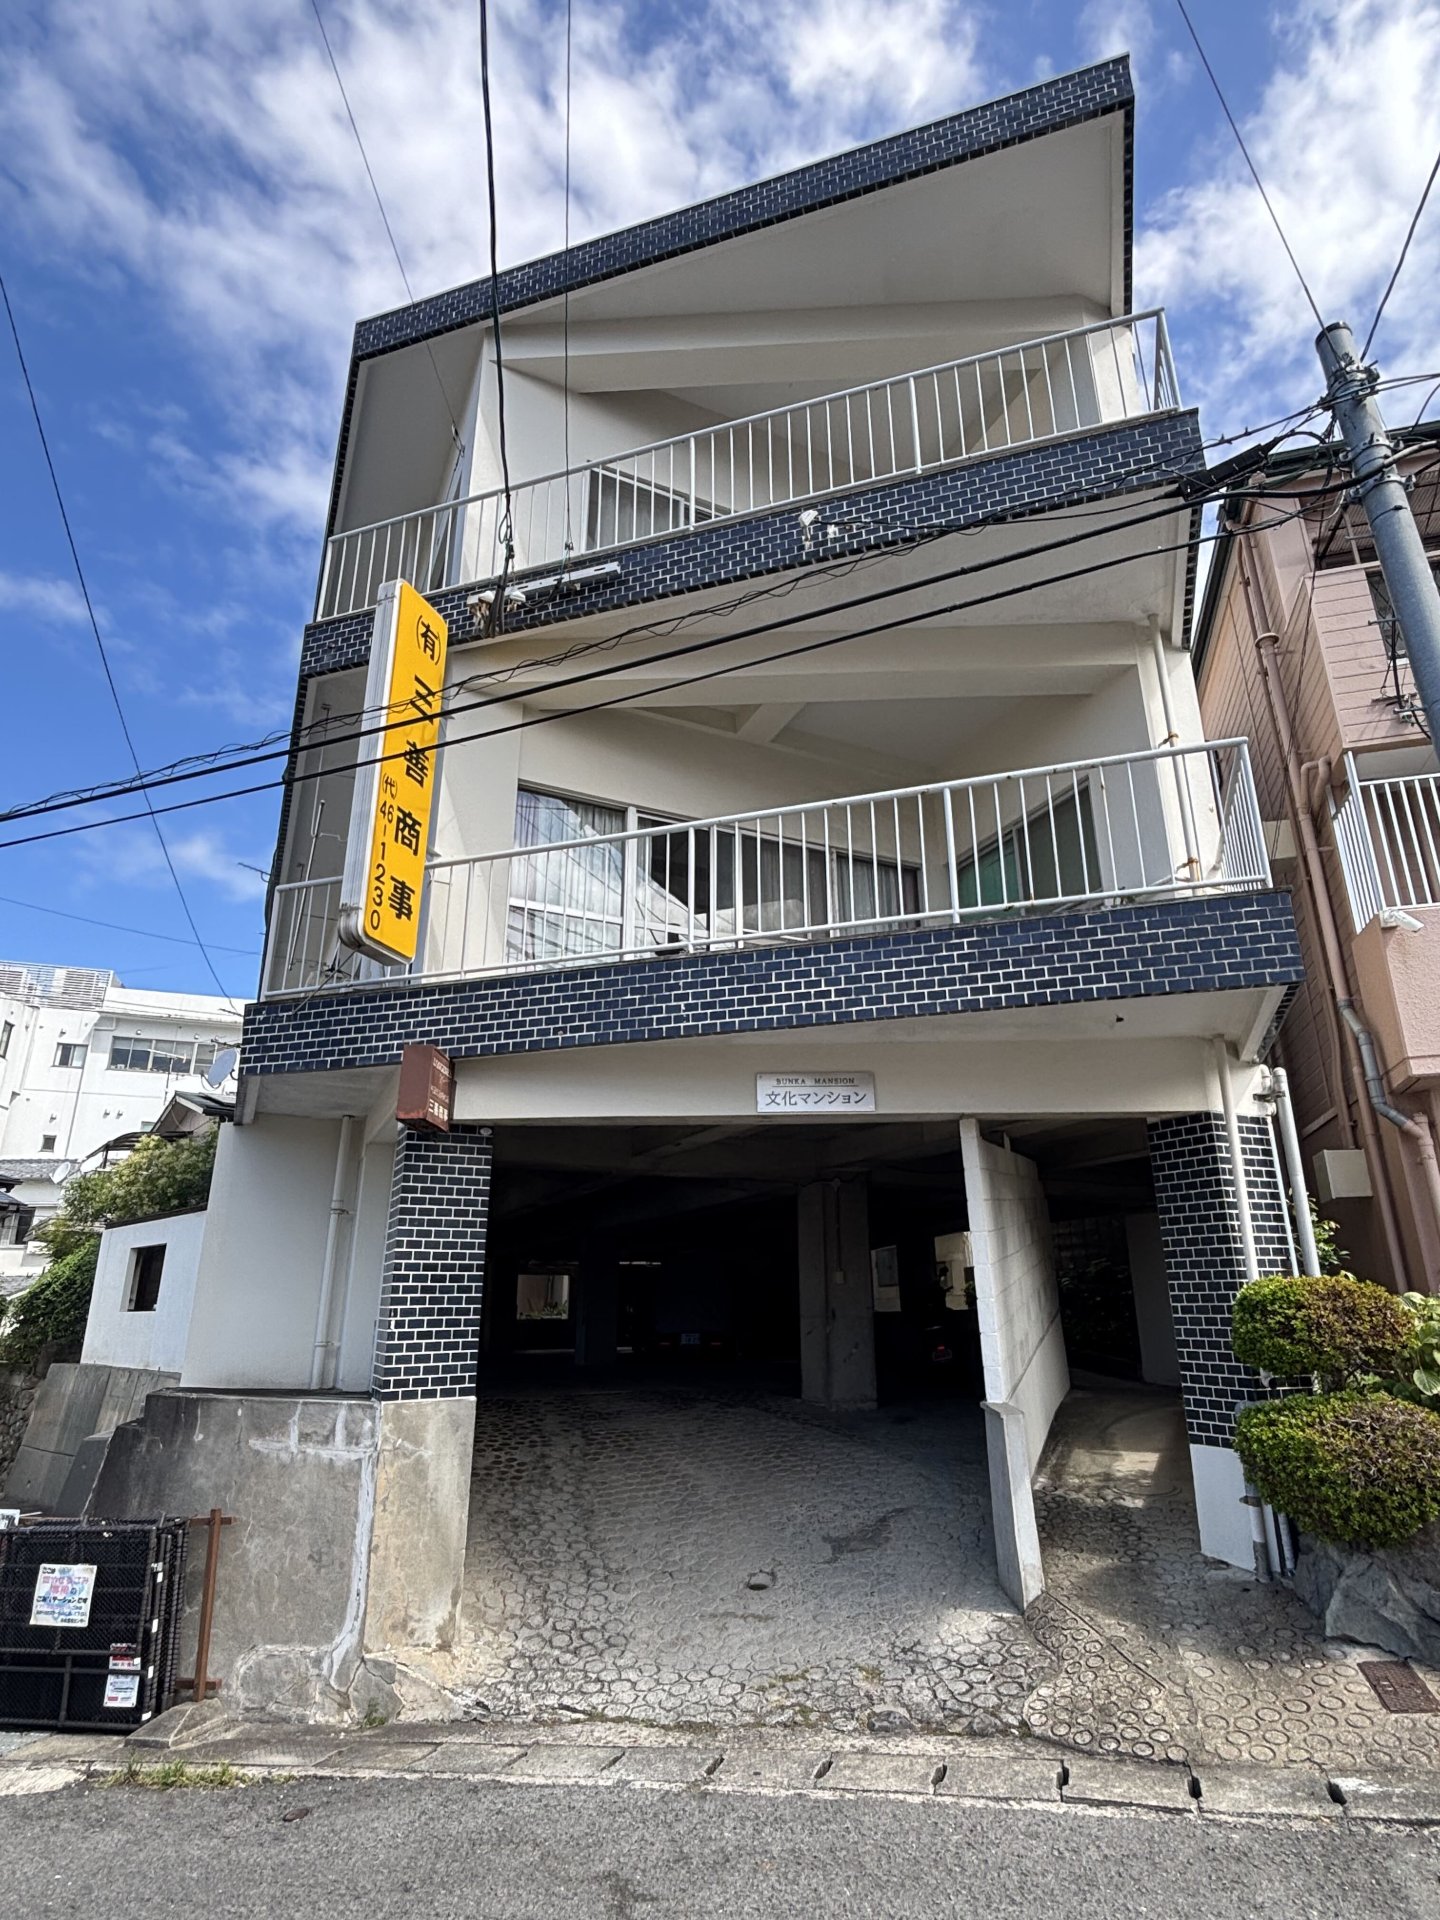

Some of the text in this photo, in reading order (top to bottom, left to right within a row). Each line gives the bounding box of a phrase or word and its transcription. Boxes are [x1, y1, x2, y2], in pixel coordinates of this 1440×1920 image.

[776, 1077, 856, 1086] BUNKA MANSION
[765, 1091, 867, 1106] 文化マンション
